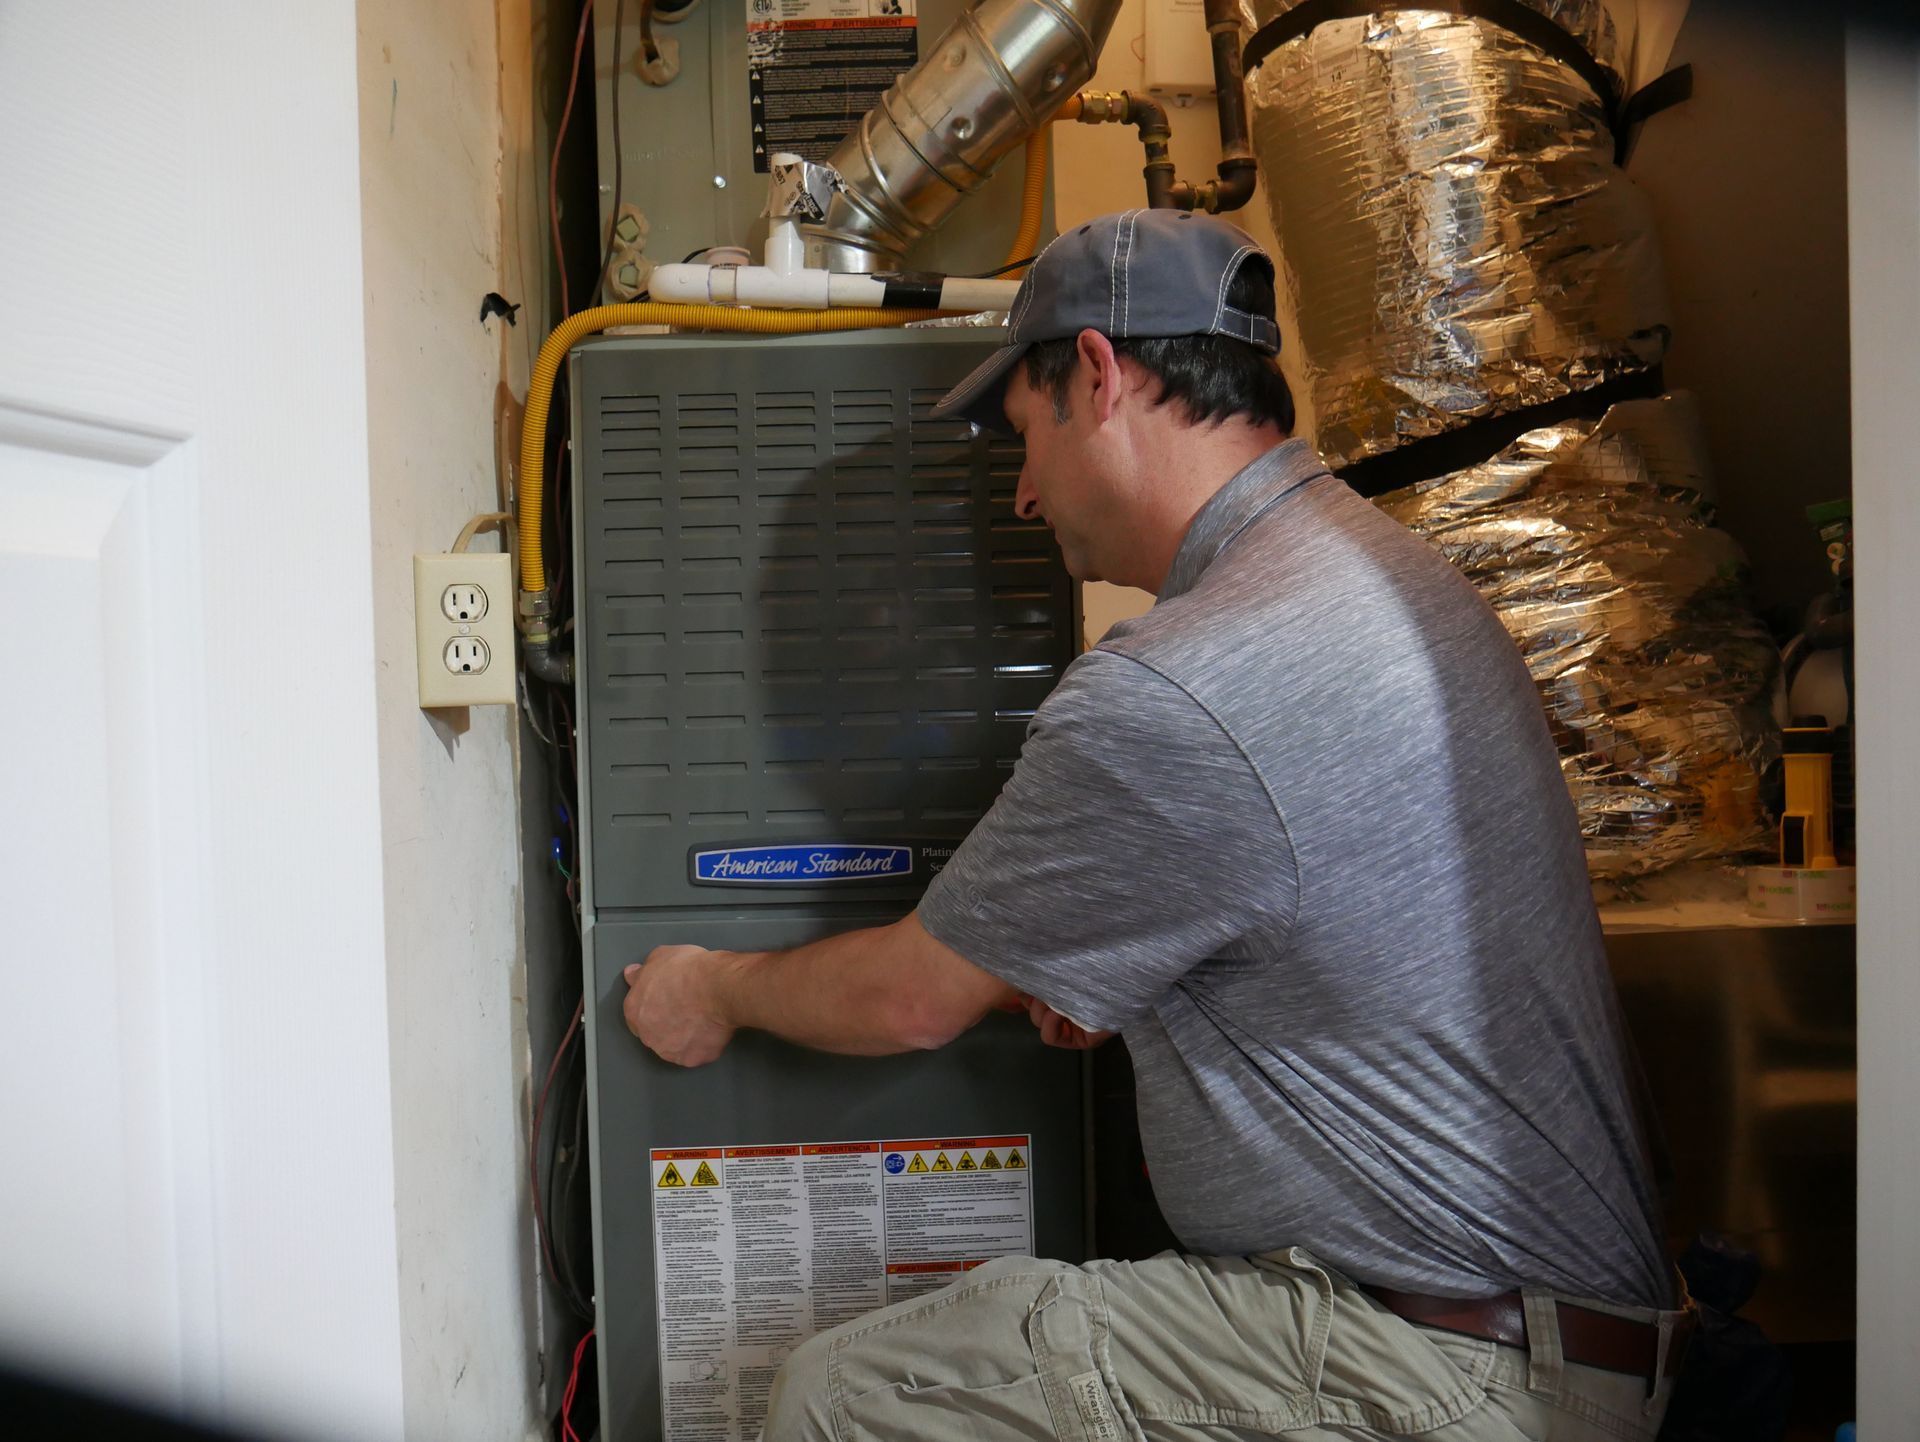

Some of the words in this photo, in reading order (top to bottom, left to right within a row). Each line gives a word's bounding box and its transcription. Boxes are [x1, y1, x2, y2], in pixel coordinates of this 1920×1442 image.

[711, 853, 798, 877] American
[803, 850, 897, 874] Standard
[930, 863, 945, 872] Se
[735, 1148, 796, 1156] AVERTISSEMENT
[818, 1145, 871, 1153] ADVERTENCIA
[672, 1150, 708, 1158] WARNING
[1086, 1380, 1109, 1439] Wrangler
